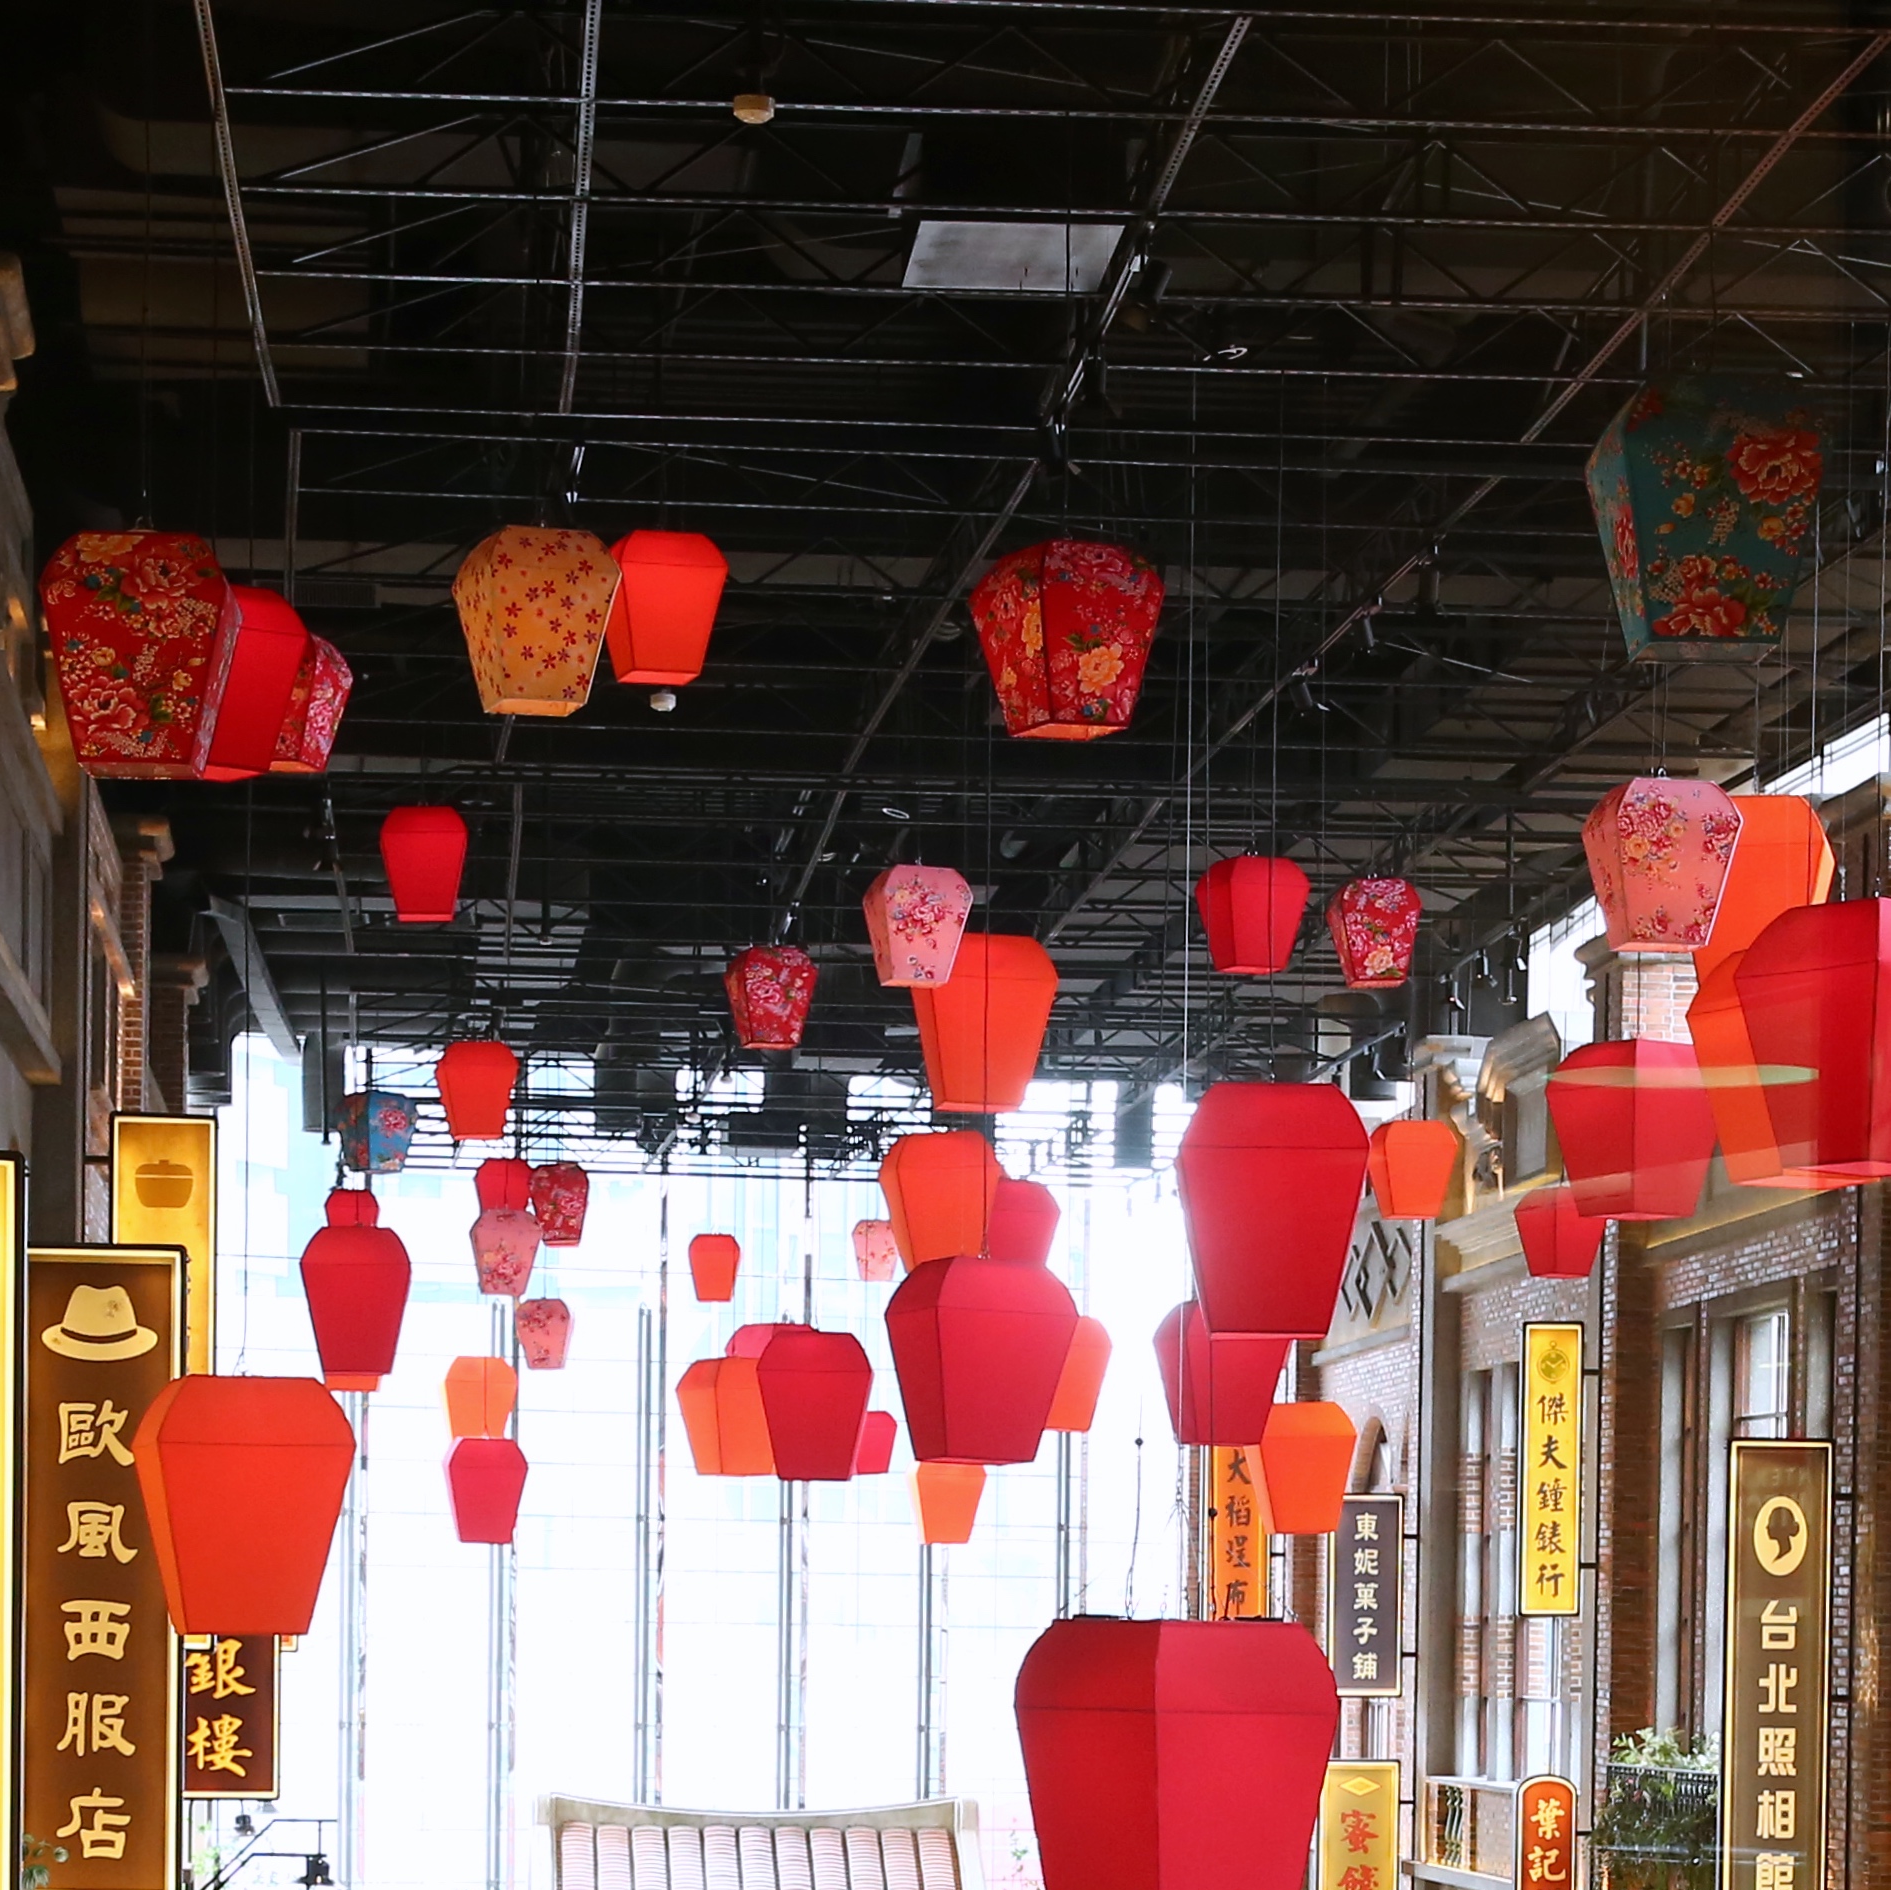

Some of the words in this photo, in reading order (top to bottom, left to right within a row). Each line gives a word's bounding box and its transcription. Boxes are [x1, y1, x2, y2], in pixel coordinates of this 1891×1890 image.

[57, 1400, 138, 1860] 歐風西服店
[184, 1638, 257, 1778] 銀樓
